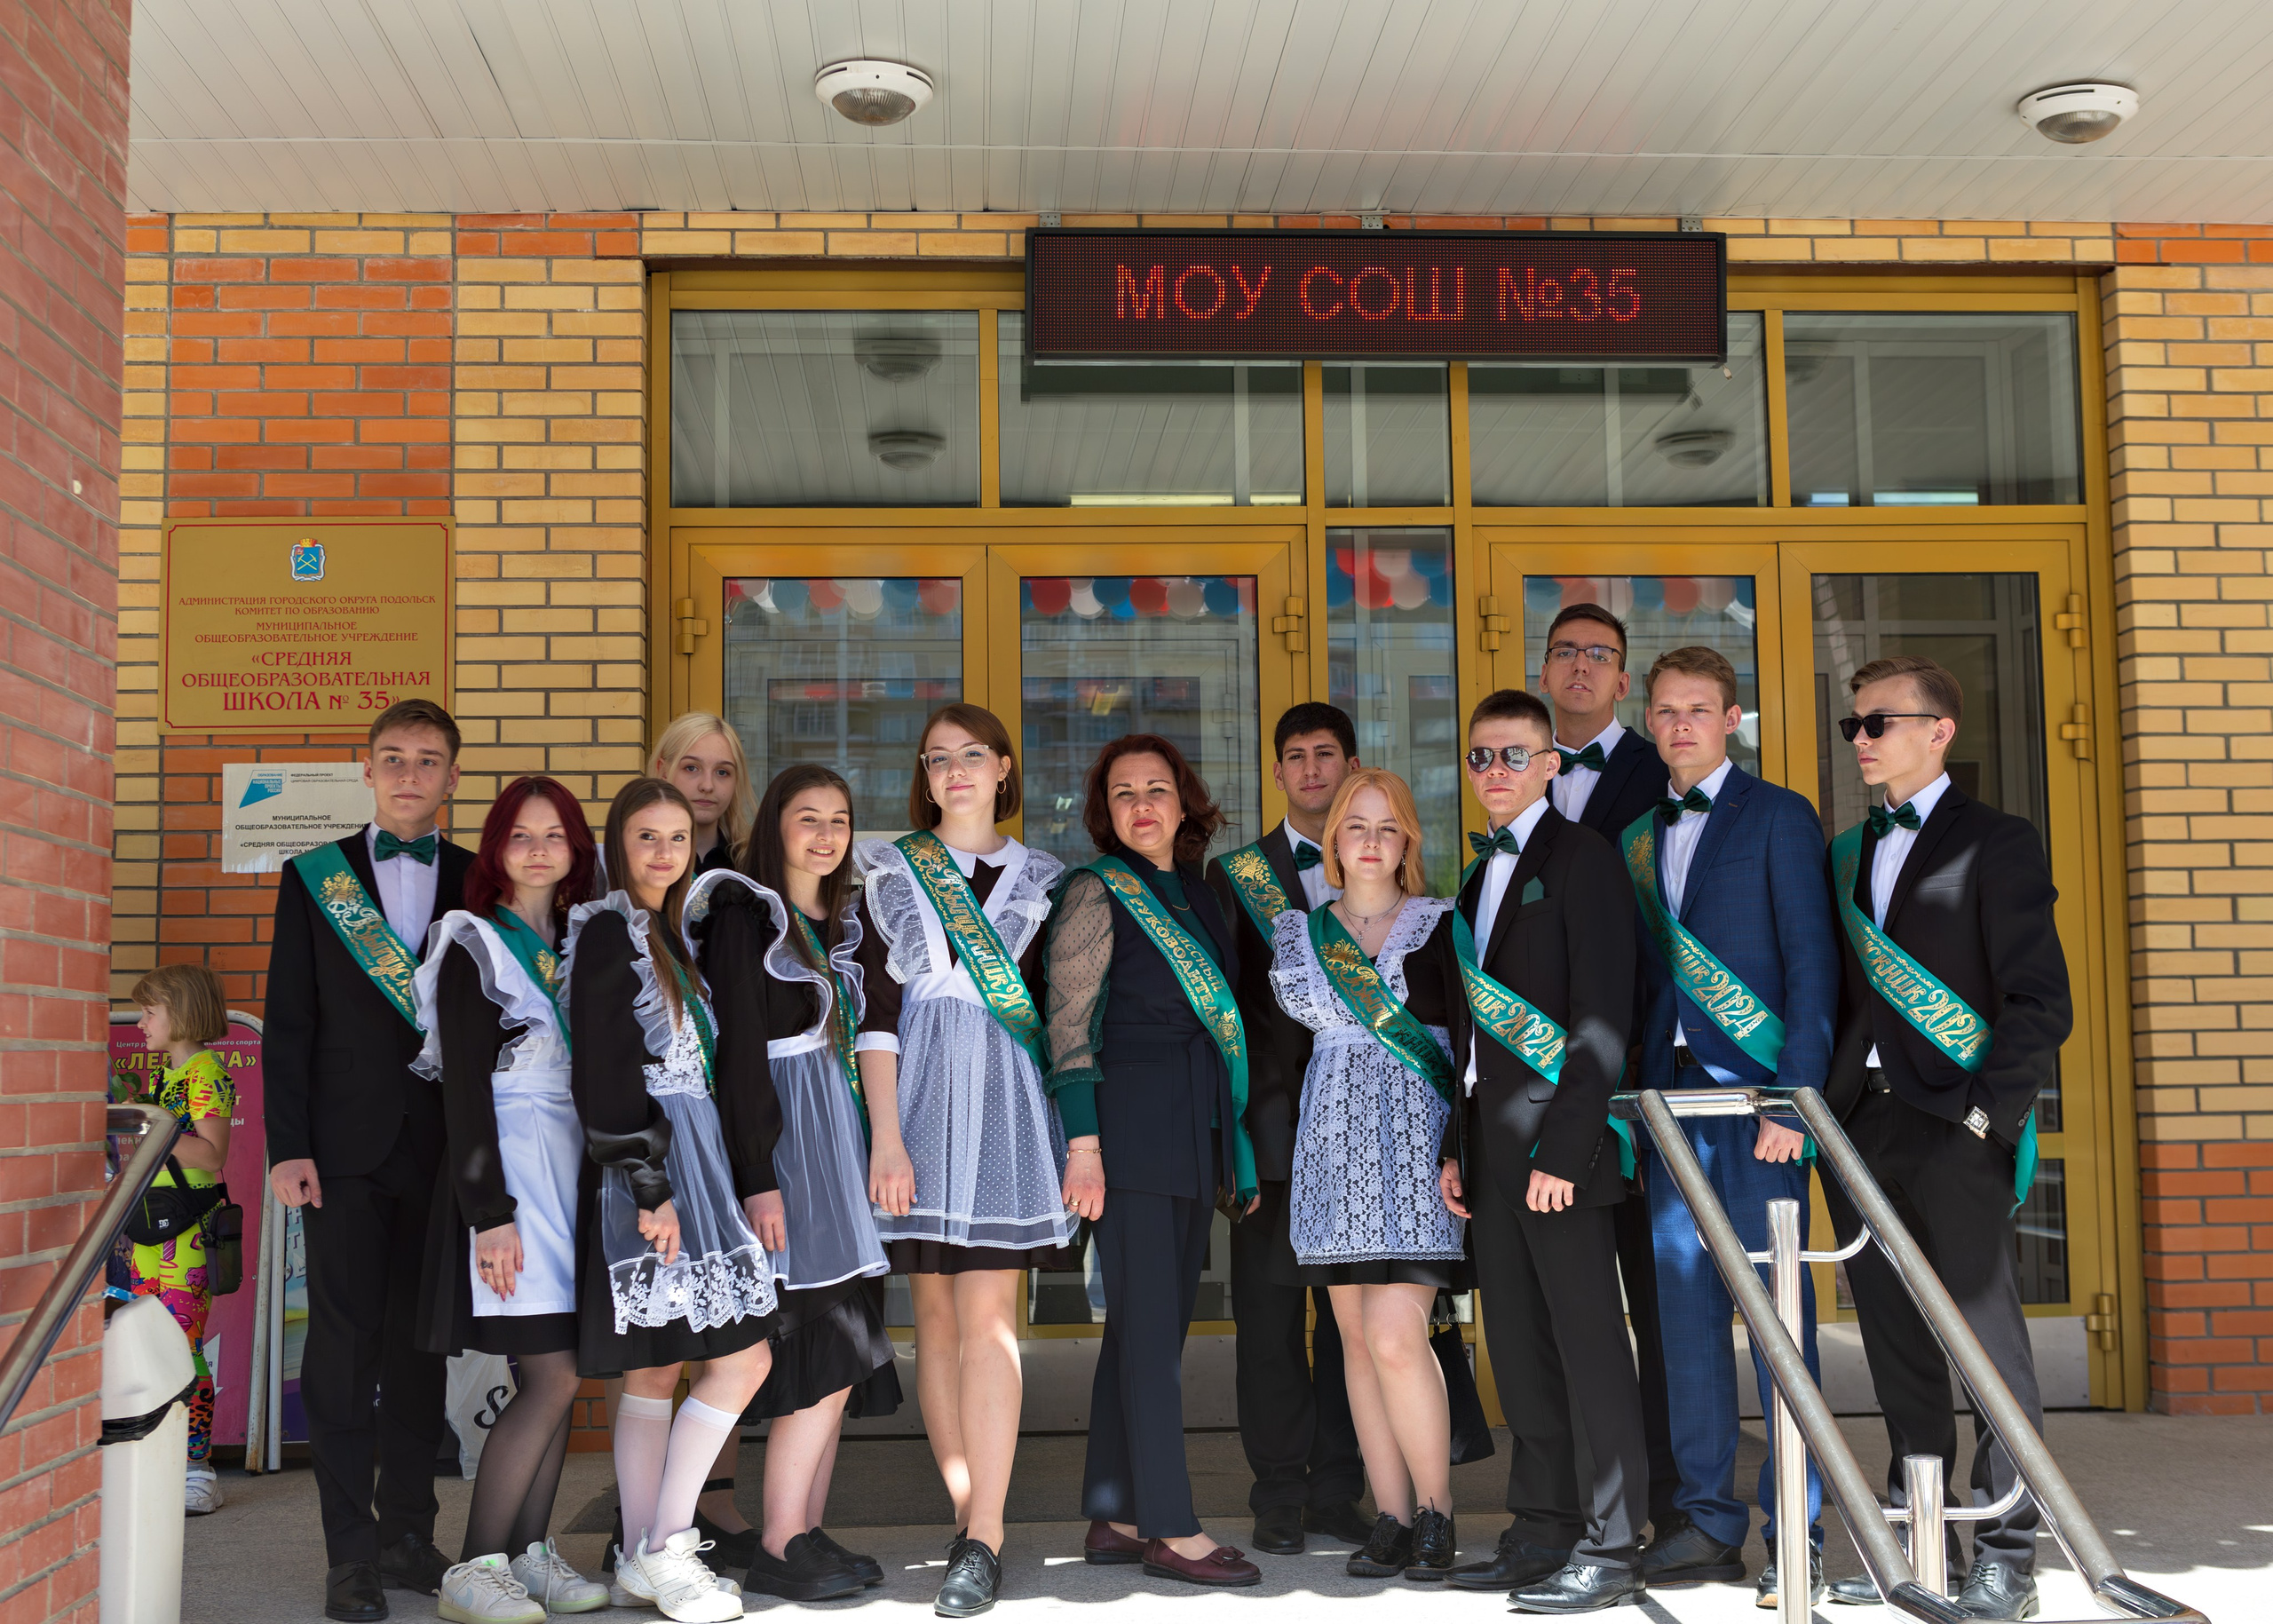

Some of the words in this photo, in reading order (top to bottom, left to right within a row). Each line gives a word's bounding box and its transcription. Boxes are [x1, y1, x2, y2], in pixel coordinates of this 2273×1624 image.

[1117, 265, 1271, 320] МОУ
[1300, 266, 1464, 321] СОШ
[1498, 267, 1642, 322] №35
[178, 597, 266, 606] АДМИНИСТРАЦИЯ
[269, 596, 337, 605] ГОРОДСКОГО
[339, 595, 377, 604] ОКРУГА
[380, 595, 436, 604] ПОДОЛЬСК
[234, 606, 282, 615] КОМИТЕТ
[303, 606, 380, 614] ОБРАЗОВАНИЮ
[194, 633, 337, 644] ОБЩЕОБРАЗОВАТЕЛЬНОЕ
[341, 632, 418, 643] УЧРЕЖДЕНИЕ
[256, 622, 357, 631] МУНИЦИПАЛЬНОЕ
[251, 652, 352, 668] «СРЕДНЯЯ
[181, 671, 431, 689] ОБЩЕОБРАЗОВАТЕЛЬНАЯ
[223, 691, 321, 711] ШКОЛА
[924, 865, 1010, 991] Выпускник
[986, 983, 1041, 1047] 2024
[1129, 898, 1219, 1027] РУКОВОДИТЕЛЬ
[1160, 915, 1224, 992] Классный
[1691, 970, 1769, 1041] 2024
[1491, 1002, 1567, 1069] 2024
[1907, 989, 1992, 1061] 2024
